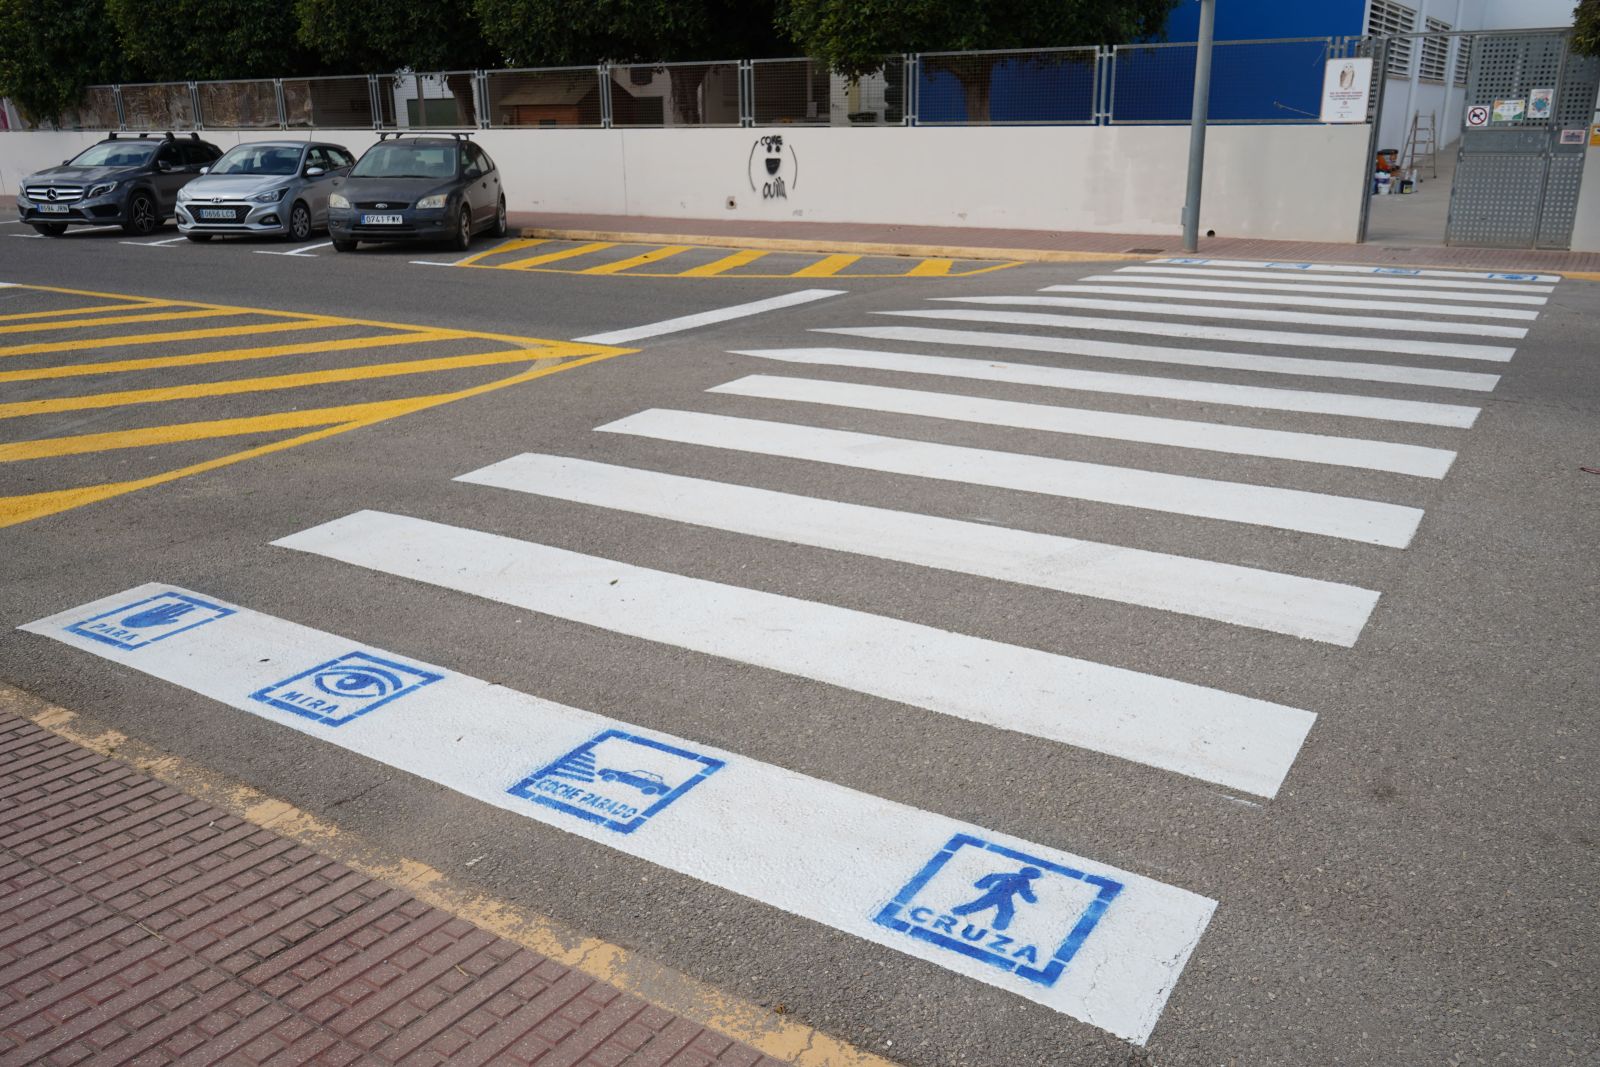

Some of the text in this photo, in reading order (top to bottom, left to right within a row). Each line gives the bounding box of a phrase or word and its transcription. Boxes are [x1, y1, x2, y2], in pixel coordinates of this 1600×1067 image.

[366, 215, 385, 223] 0741
[89, 623, 139, 641] PARA
[280, 691, 339, 713] MIRA
[535, 780, 638, 818] COCHE PARADO
[909, 907, 1037, 963] CRUZA
